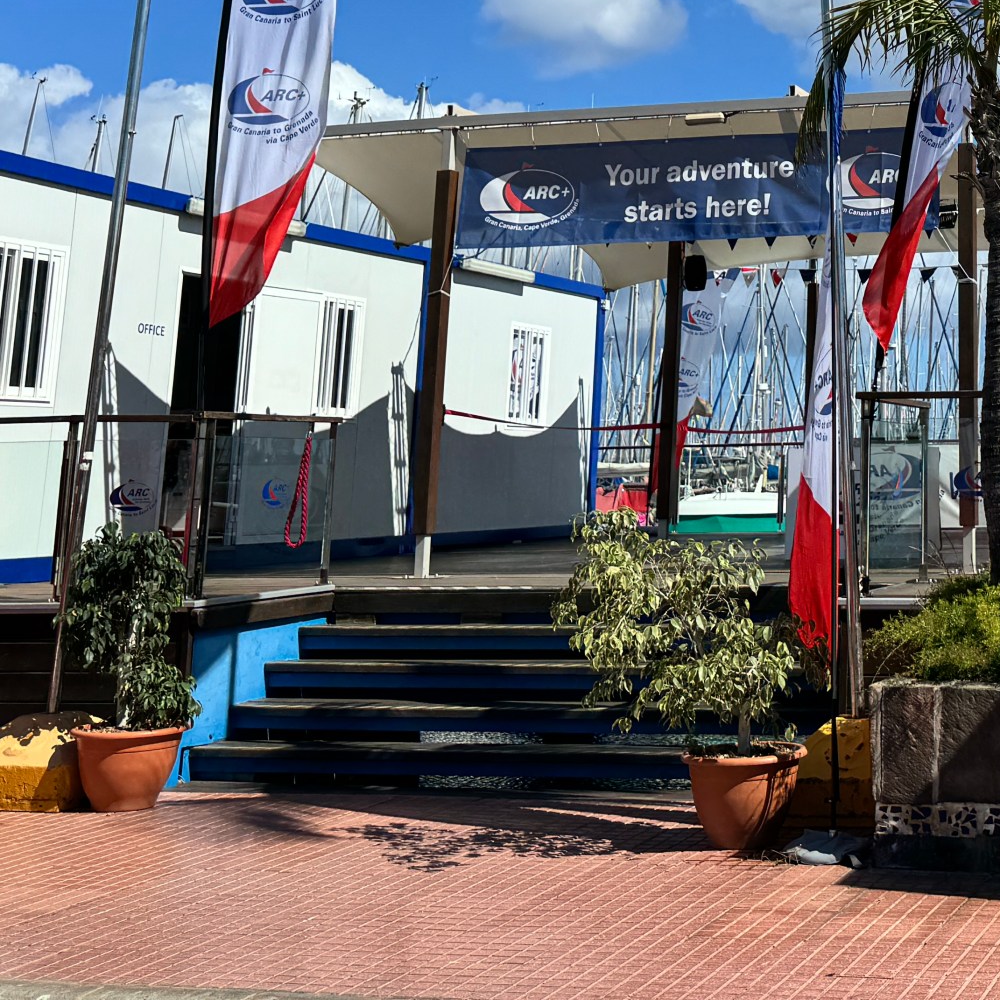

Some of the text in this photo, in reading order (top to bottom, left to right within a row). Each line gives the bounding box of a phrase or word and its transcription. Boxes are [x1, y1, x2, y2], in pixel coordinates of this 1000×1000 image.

[239, 6, 254, 19] Gran
[255, 15, 281, 25] Canaria
[293, 9, 312, 21] Saint
[260, 88, 305, 102] ARC+
[227, 122, 243, 133] Gran
[244, 127, 271, 136] Canaria
[284, 110, 313, 132] Grenada
[265, 118, 319, 144] via Cape Verde
[604, 159, 795, 187] Your adventure
[522, 185, 570, 200] ARC+
[624, 193, 771, 223] starts here!
[484, 216, 498, 227] Gran
[693, 310, 713, 320] ARC
[137, 322, 165, 337] OFFICE
[127, 488, 150, 497] ARC
